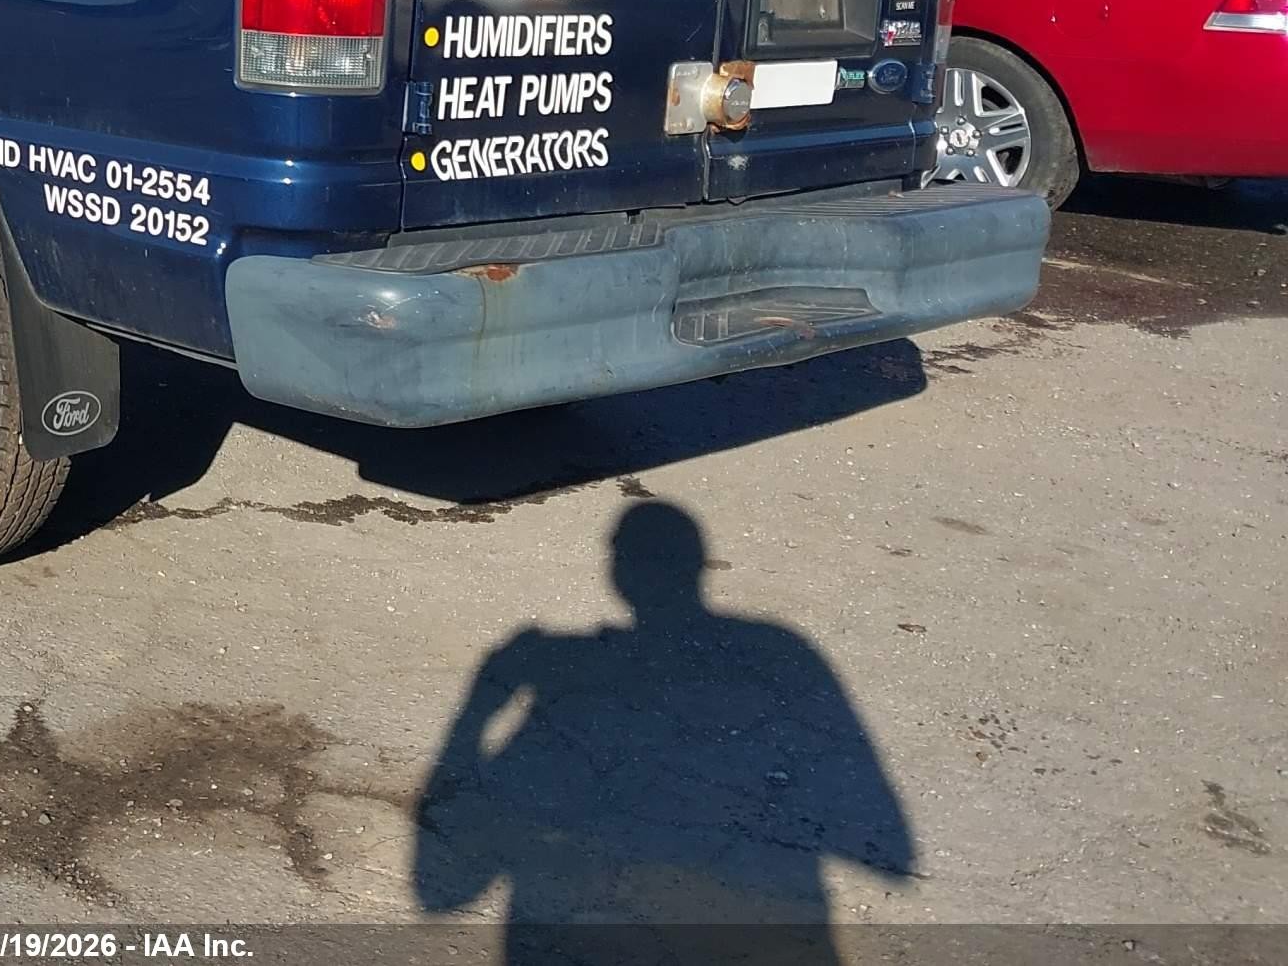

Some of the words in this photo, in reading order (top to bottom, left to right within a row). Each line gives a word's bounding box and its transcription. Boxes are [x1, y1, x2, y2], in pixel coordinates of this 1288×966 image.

[896, 2, 908, 11] SCAN
[908, 1, 915, 10] ME
[443, 14, 613, 59] HUMIDIFIERS
[438, 75, 512, 120] HEAT
[518, 71, 613, 116] PUMPS
[29, 145, 97, 183] HVAC
[105, 161, 211, 206] 01-2554
[431, 128, 609, 181] GENERATORS
[43, 183, 121, 226] WSSD
[130, 204, 210, 246] 20152
[52, 397, 90, 430] Ford
